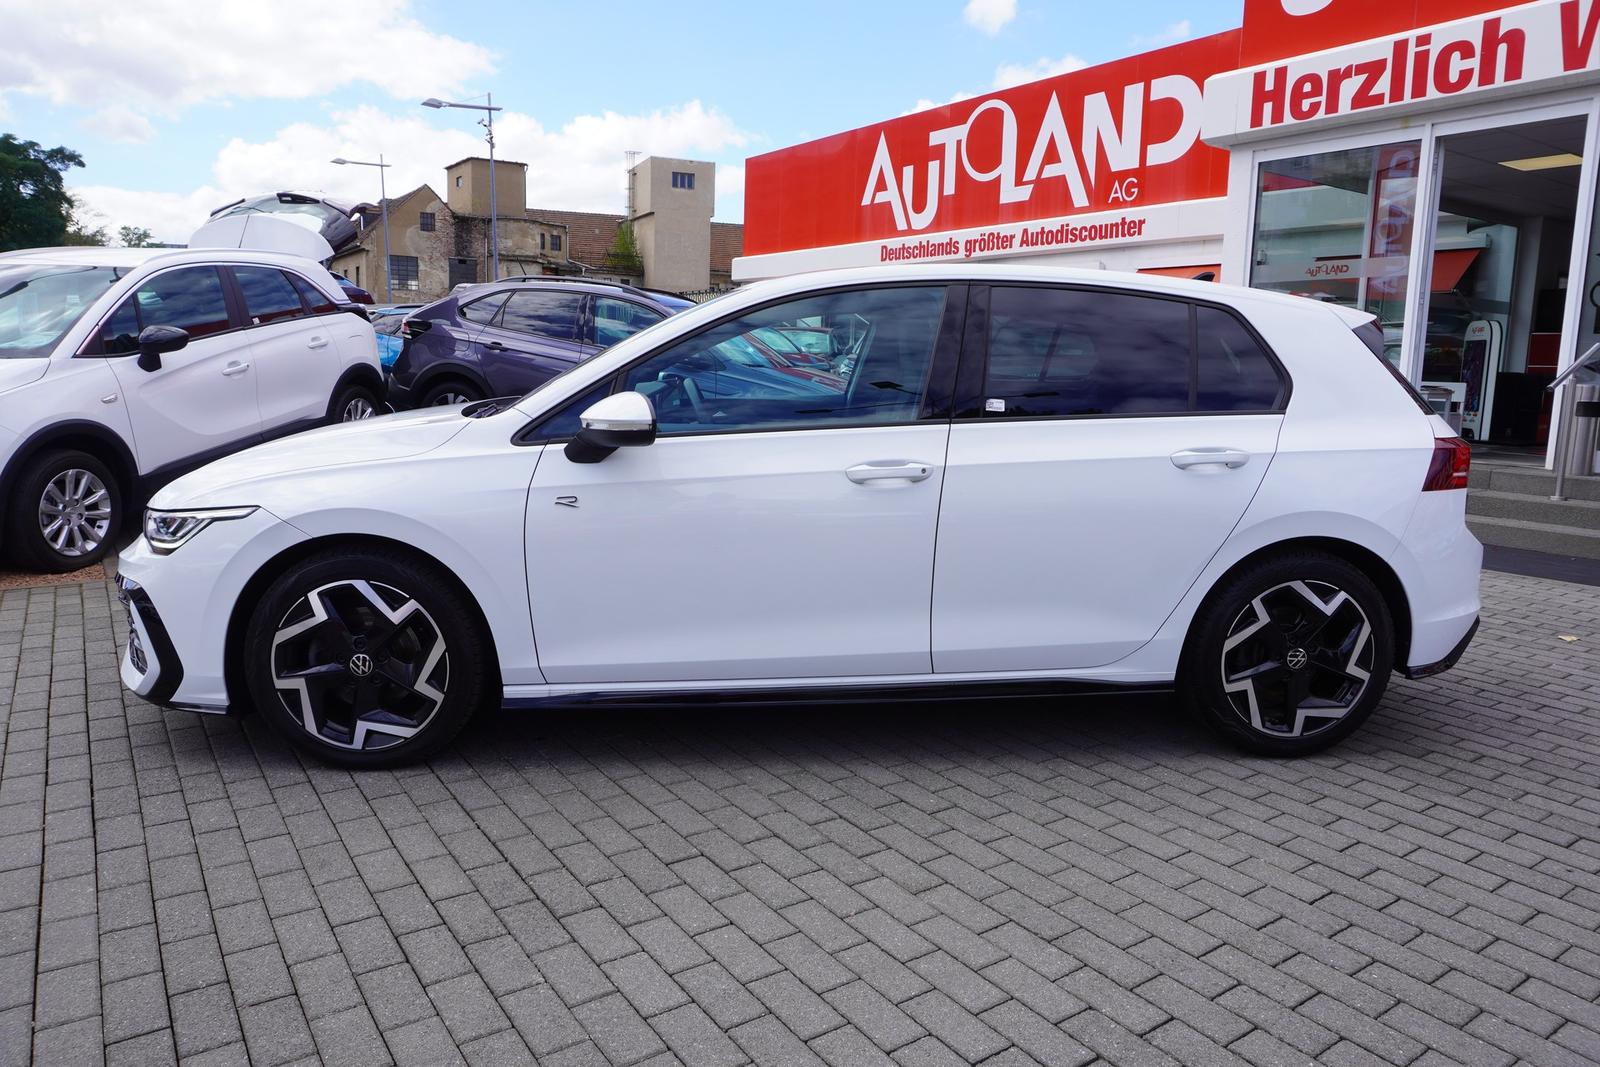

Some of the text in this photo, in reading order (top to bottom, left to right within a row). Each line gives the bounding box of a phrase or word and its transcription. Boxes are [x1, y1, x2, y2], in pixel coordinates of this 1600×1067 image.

[1250, 17, 1526, 129] Herzlich
[861, 74, 1204, 231] AUTOLAND
[1108, 178, 1138, 204] AG
[880, 217, 1147, 262] Deutschlands größter Autodiscounter
